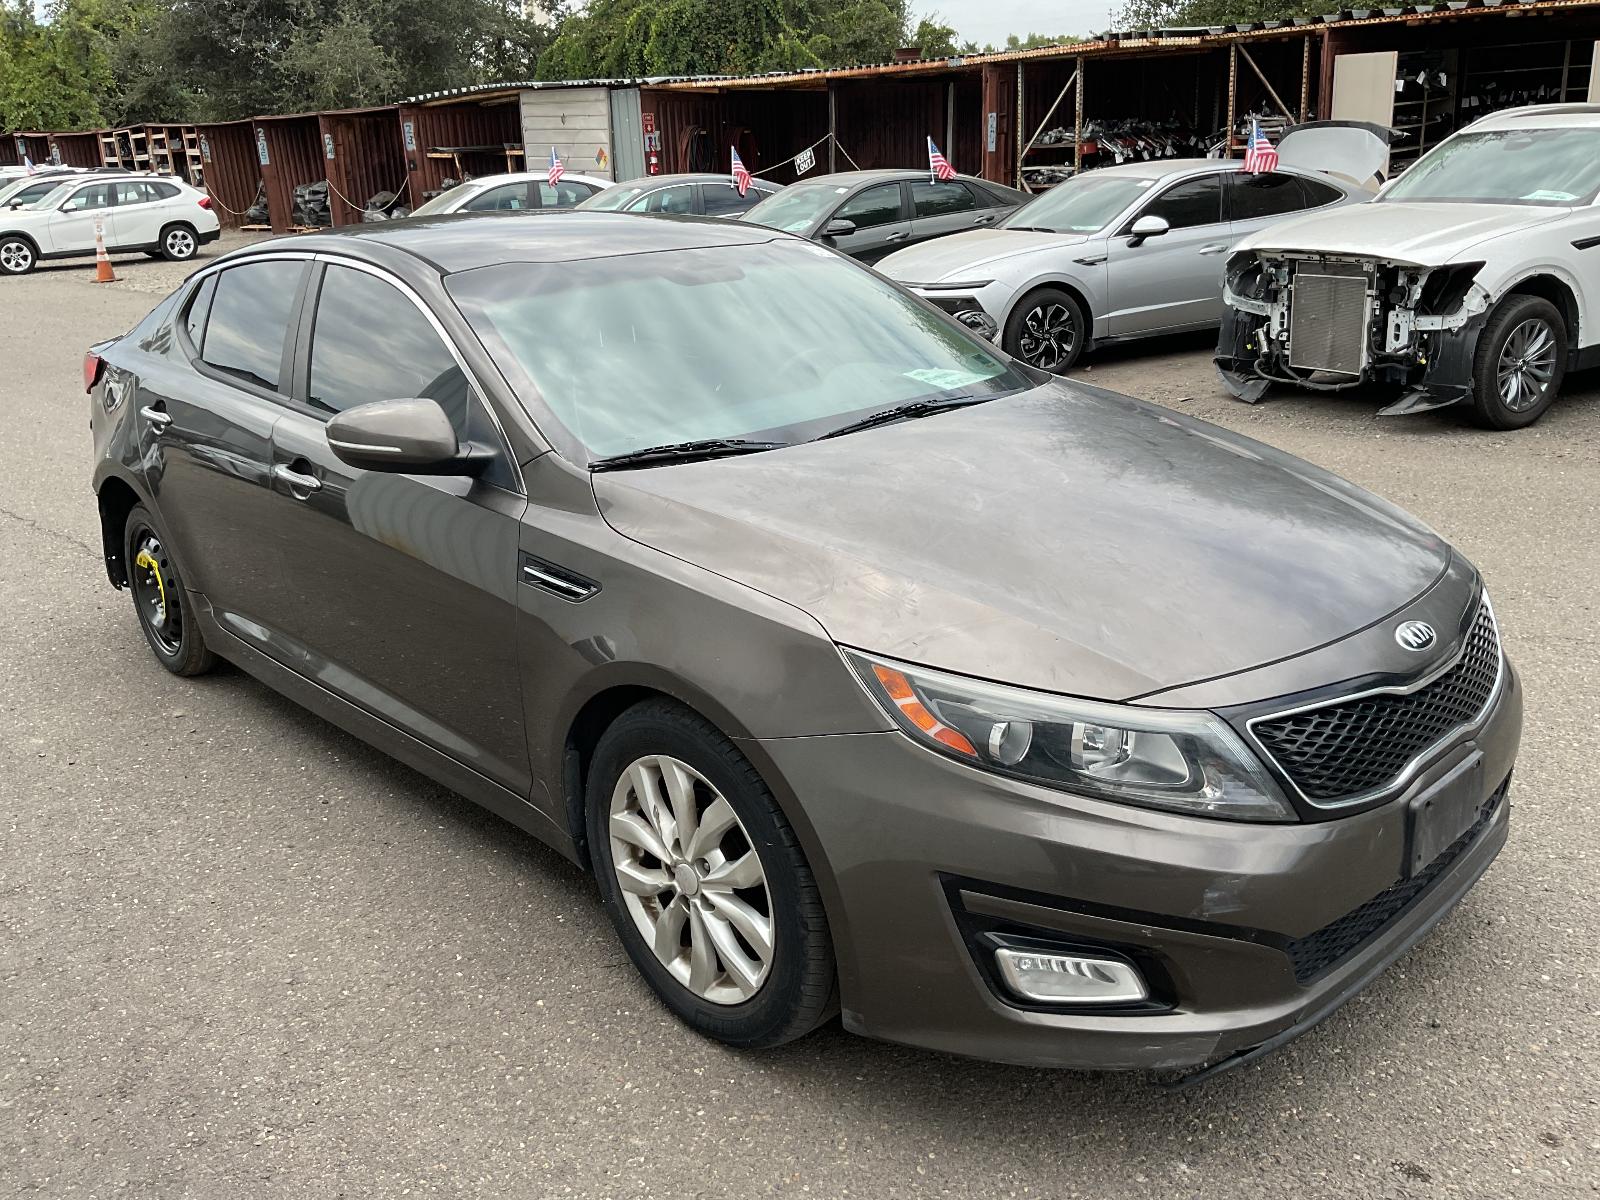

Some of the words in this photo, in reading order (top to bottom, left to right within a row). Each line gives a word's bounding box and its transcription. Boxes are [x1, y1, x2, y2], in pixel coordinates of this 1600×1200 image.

[796, 151, 811, 165] KEEP
[799, 159, 812, 171] OUT
[1401, 623, 1434, 647] KIA
